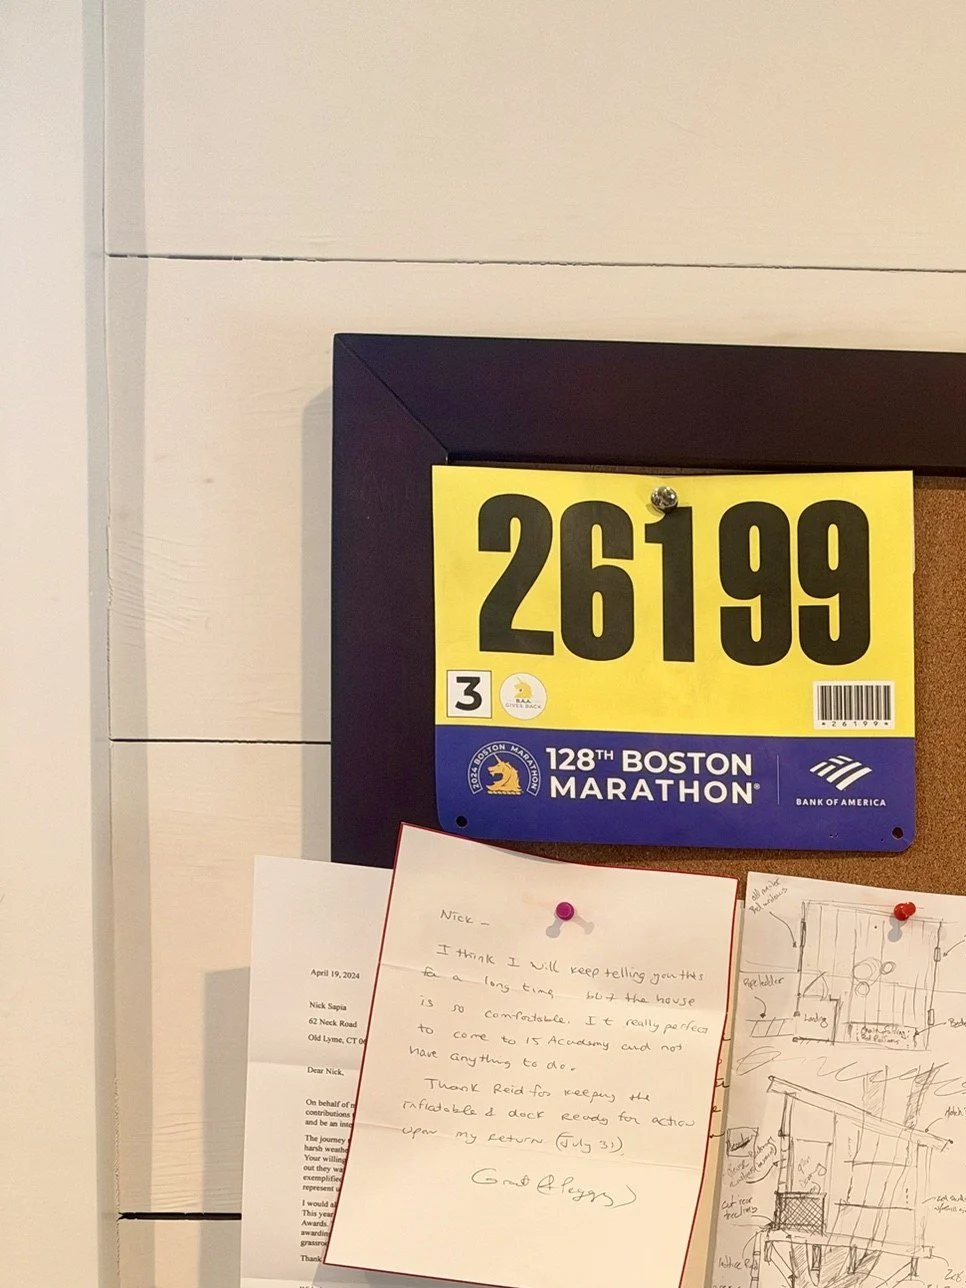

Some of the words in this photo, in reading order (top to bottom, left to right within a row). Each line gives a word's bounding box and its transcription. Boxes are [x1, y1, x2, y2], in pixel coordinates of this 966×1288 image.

[478, 493, 871, 666] 26199
[455, 676, 482, 711] 3
[469, 768, 478, 789] 2024
[474, 744, 506, 765] BOSTON
[511, 745, 539, 793] MARATHON
[622, 750, 752, 776] BOSTON
[841, 799, 886, 807] AMERICA
[440, 910, 473, 925] Nick
[436, 944, 449, 956] I
[456, 948, 495, 965] think
[311, 969, 328, 978] April
[309, 1001, 325, 1009] Nick
[328, 1003, 347, 1011] Sapia
[326, 1068, 344, 1076] Nick,
